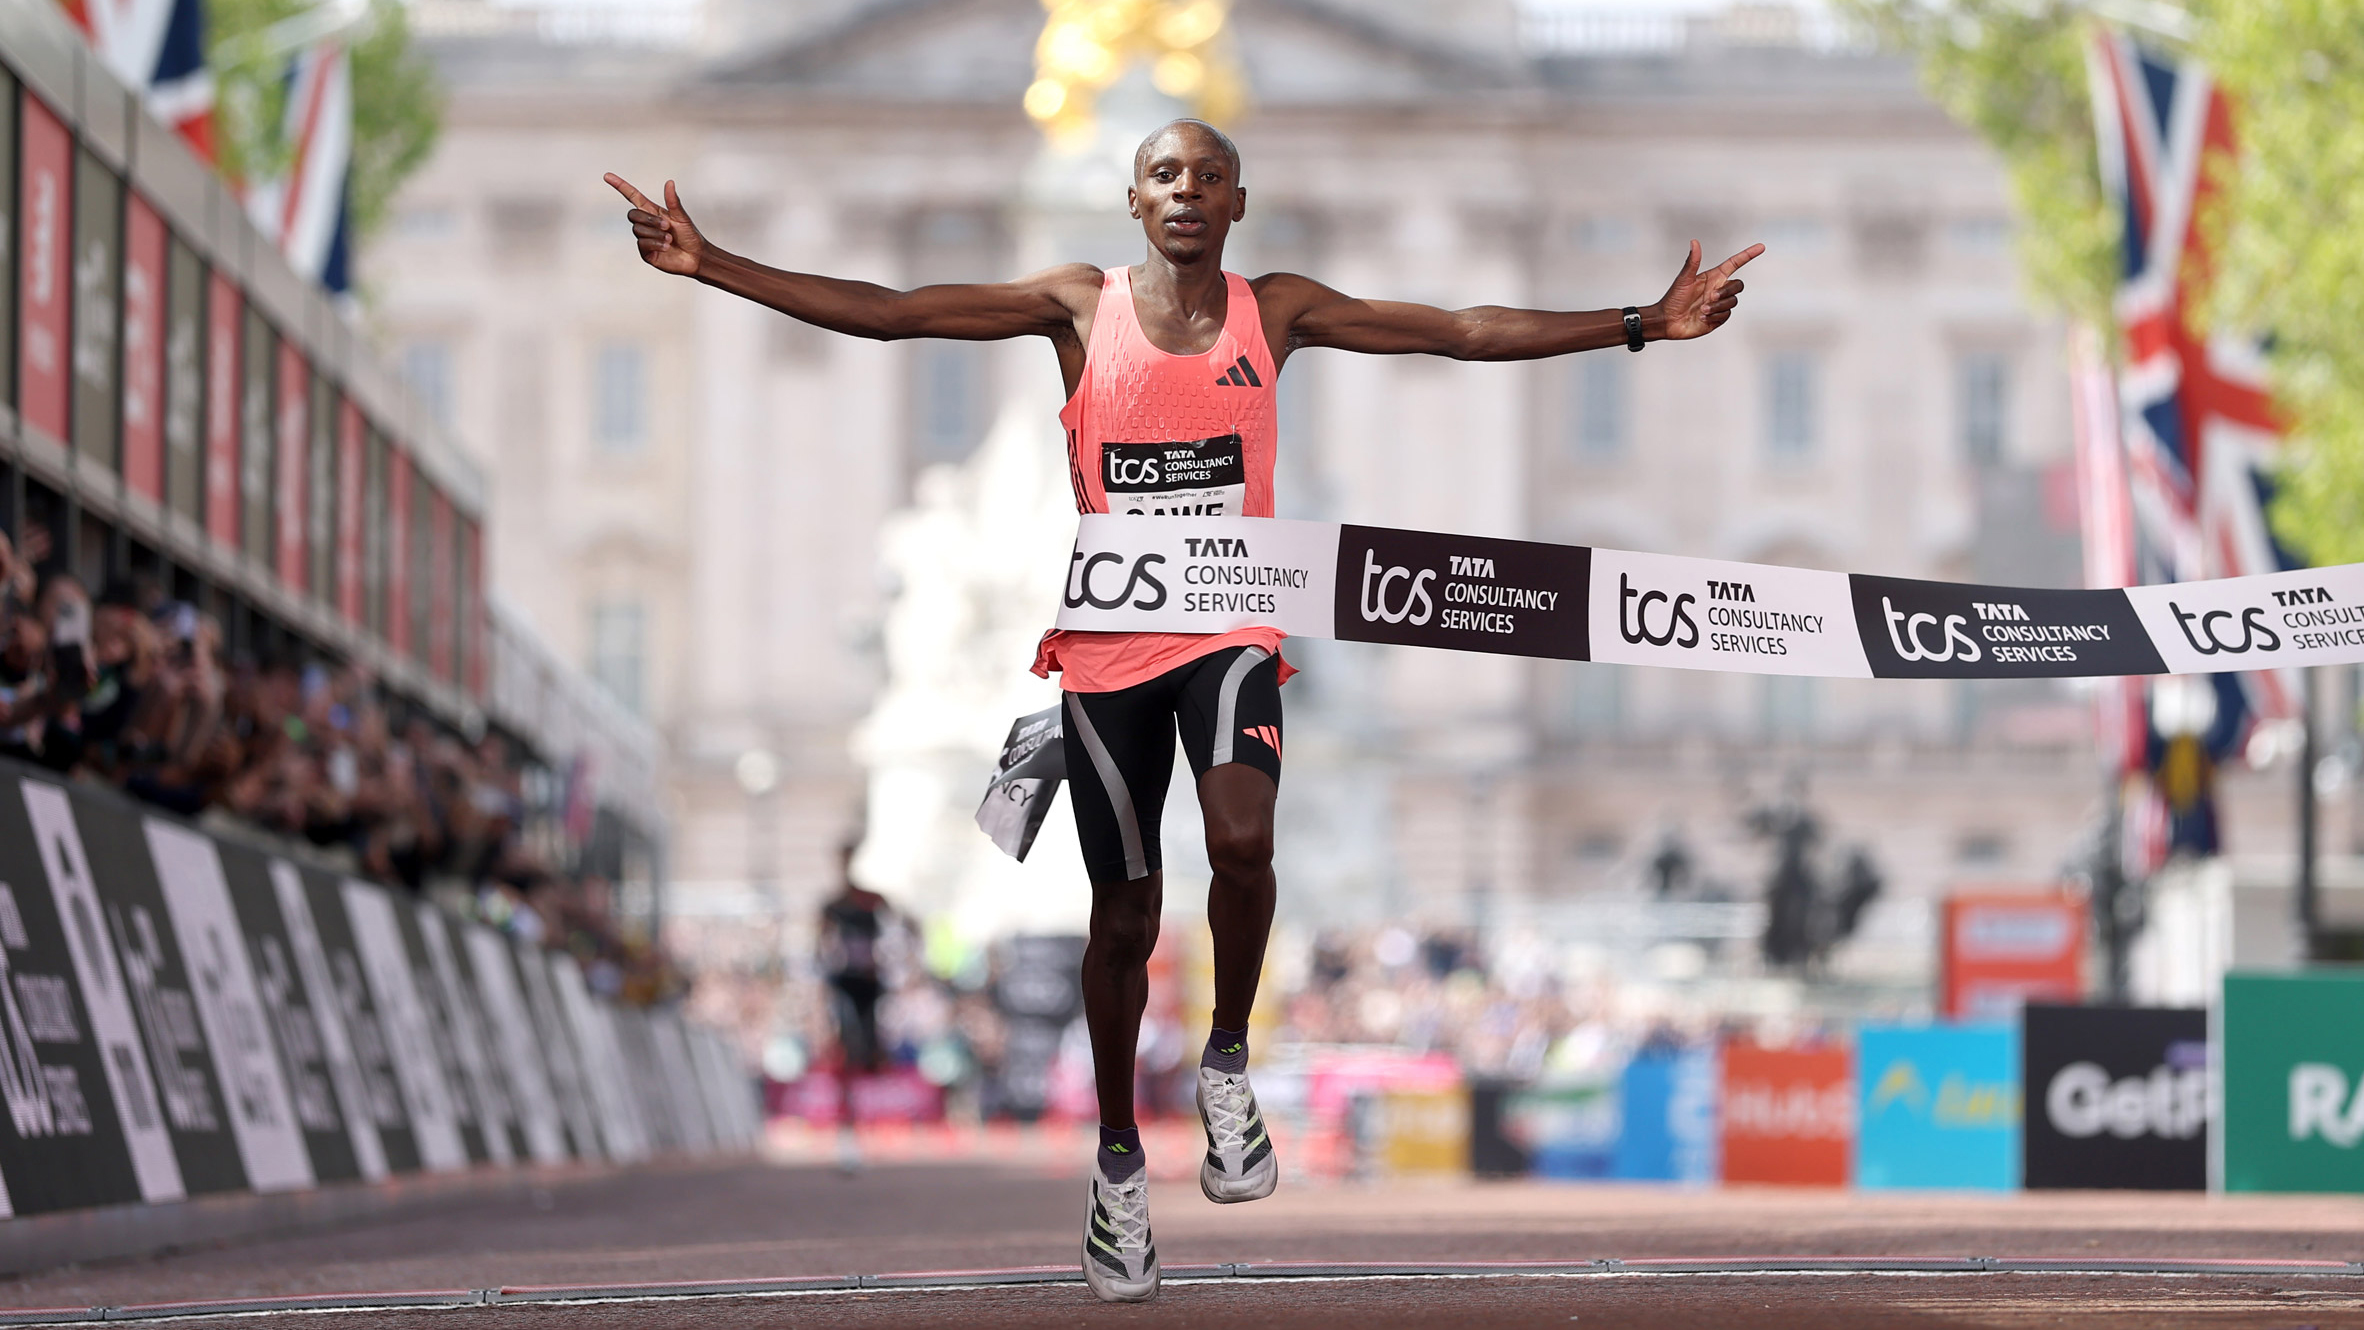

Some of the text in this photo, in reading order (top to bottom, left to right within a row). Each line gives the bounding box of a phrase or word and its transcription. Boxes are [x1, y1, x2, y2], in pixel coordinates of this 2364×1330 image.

[1164, 449, 1196, 460] TATA
[1164, 455, 1235, 472] CONSULTANCY
[1110, 451, 1160, 485] tcs
[1165, 470, 1212, 483] SERVICES
[1184, 538, 1249, 558] TATA
[1064, 537, 1168, 612] tcs
[1184, 565, 1309, 589] CONSULTANCY
[1449, 554, 1496, 580] TATA
[1360, 547, 1437, 627] tcs
[1444, 581, 1559, 612] CONSULTANCY
[1706, 579, 1756, 603] TATA
[2271, 587, 2334, 607] TATA
[1184, 592, 1276, 613] SERVICES
[1619, 571, 1700, 650] tcs
[1971, 601, 2032, 622] TATA
[1440, 608, 1515, 635] SERVICES
[1707, 606, 1824, 634] CONSULTANCY
[1881, 595, 1982, 664] tcs
[2168, 601, 2281, 655] tcs
[1710, 632, 1788, 656] SERVICES
[1981, 624, 2112, 643] CONSULTANCY
[1990, 645, 2078, 664] SERVICES
